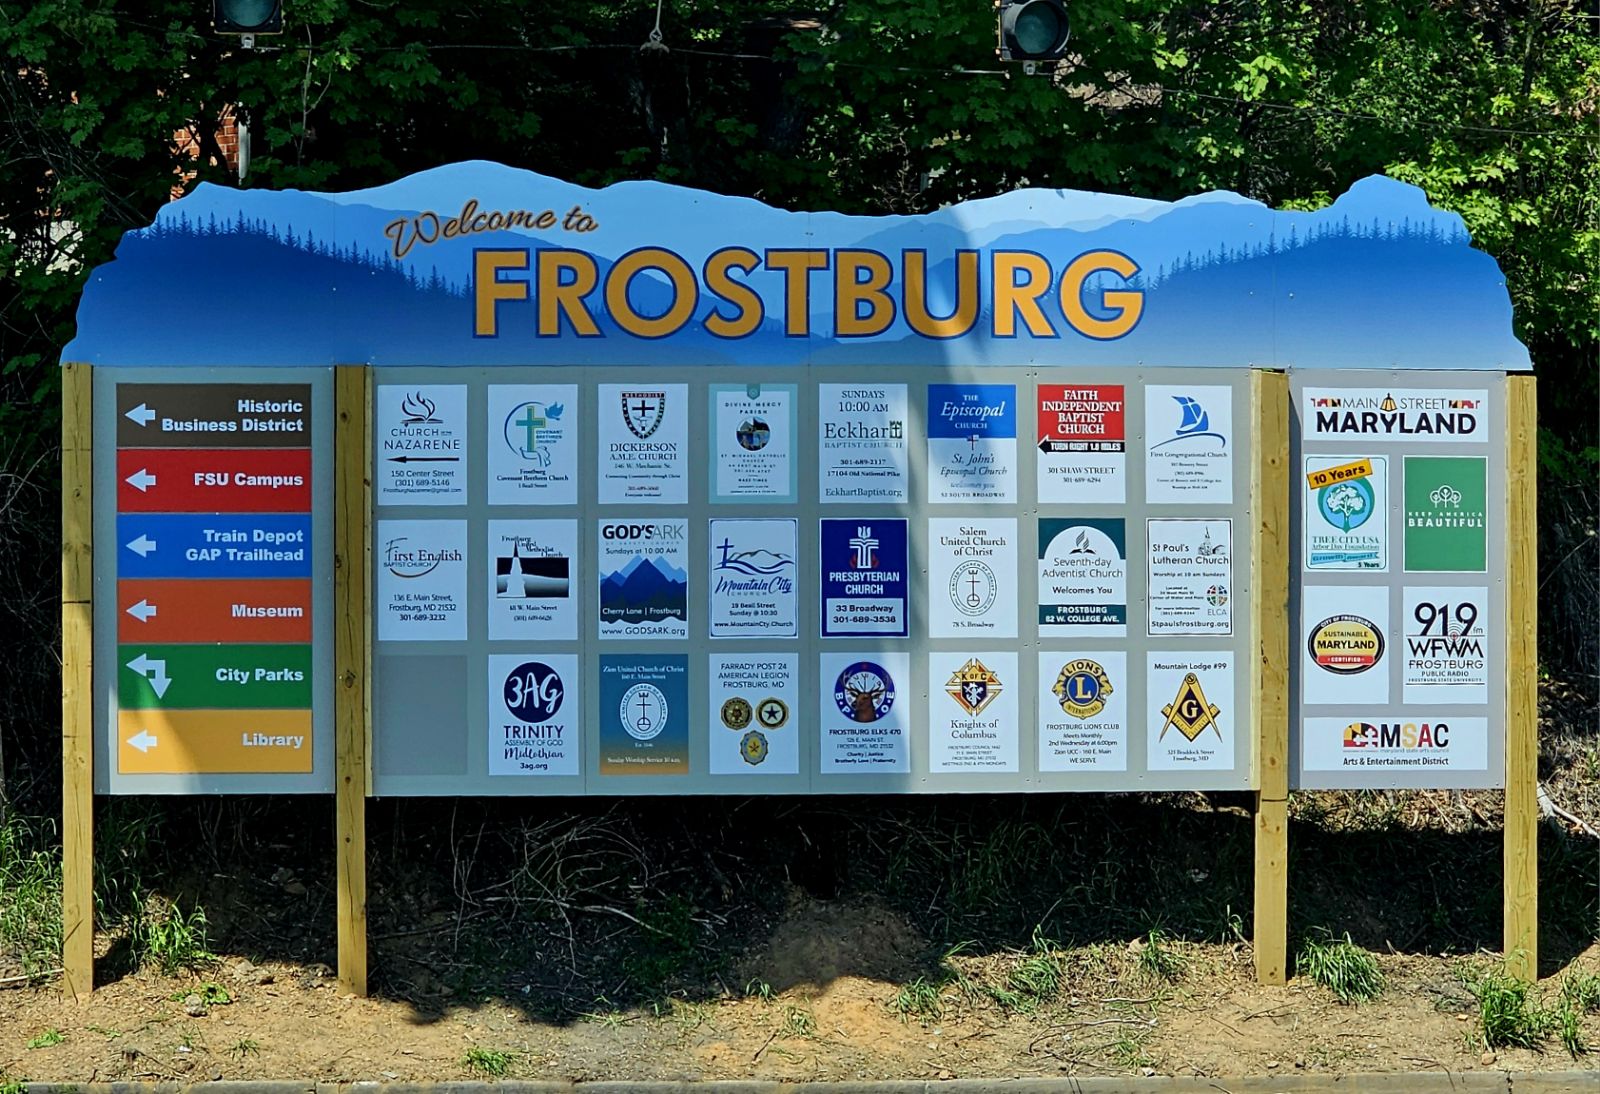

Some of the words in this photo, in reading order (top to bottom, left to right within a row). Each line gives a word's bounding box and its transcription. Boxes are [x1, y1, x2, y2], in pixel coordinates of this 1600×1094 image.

[384, 199, 556, 258] Welcome
[562, 205, 598, 232] to
[472, 246, 1145, 341] FROSTBURG
[1064, 390, 1098, 400] FAITH
[238, 400, 303, 412] Historic
[839, 402, 870, 412] 10:00
[873, 404, 888, 412] AM
[1042, 401, 1122, 411] INDEPENDENT
[1343, 397, 1379, 408] MAIN
[1400, 398, 1446, 410] STREET
[941, 401, 1005, 421] Episcopal
[1058, 413, 1104, 423] BAPTIST
[1317, 411, 1477, 434] MARYLAND
[162, 419, 237, 431] Business
[242, 419, 303, 431] District
[1058, 424, 1104, 434] CHURCH
[384, 440, 460, 450] NAZARENE
[610, 443, 677, 451] DICKERSON
[940, 466, 976, 477] Episcopal
[978, 466, 1007, 475] Church
[1314, 474, 1327, 485] 10
[1329, 465, 1365, 481] Years
[194, 473, 228, 485] FSU
[234, 473, 303, 488] Campus
[826, 488, 902, 497] EckhartBaptist.org
[1408, 518, 1483, 527] BEAUTIFUL
[960, 527, 987, 536] Salem
[204, 530, 247, 542] Train
[253, 530, 303, 545] Depot
[940, 537, 970, 546] United
[972, 537, 1006, 546] Church
[1312, 536, 1338, 544] TREE
[385, 537, 414, 562] First
[418, 549, 462, 564] English
[954, 547, 964, 556] of
[965, 547, 993, 556] Christ
[1163, 544, 1189, 552] Paul's
[186, 549, 220, 561] GAP
[226, 549, 303, 561] Trailhead
[1153, 556, 1192, 564] Lutheran
[1195, 556, 1229, 564] Church
[1054, 557, 1111, 568] Seventh-day
[829, 572, 900, 582] PRESBYTERIAN
[1042, 569, 1086, 577] Adventist
[1090, 569, 1123, 577] Church
[715, 576, 768, 596] Mountain
[768, 576, 792, 594] City
[845, 584, 884, 594] CHURCH
[1052, 586, 1094, 594] Welcomes
[1097, 586, 1112, 594] You
[232, 605, 303, 617] Museum
[389, 604, 422, 613] Frostburg,
[602, 608, 624, 616] Cherry
[849, 605, 893, 613] Broadway
[1057, 606, 1107, 614] FROSTBURG
[602, 627, 685, 636] www.GODSARK.org
[1317, 640, 1375, 649] MARYLAND
[1407, 638, 1484, 658] WFWM
[1066, 661, 1100, 674] LIONS
[1190, 663, 1212, 671] Lodge
[1409, 660, 1483, 669] FROSTBURG
[216, 668, 249, 684] City
[255, 669, 303, 681] Parks
[507, 672, 562, 713] 3AG
[1074, 677, 1091, 699] L
[1181, 700, 1198, 718] G
[951, 720, 986, 730] Knights
[989, 719, 999, 728] of
[504, 726, 564, 738] TRINITY
[951, 730, 997, 739] Columbus
[1380, 723, 1449, 748] MSAC
[242, 733, 303, 748] Library
[505, 747, 564, 760] Midlothian
[1343, 757, 1357, 766] Arts
[1359, 757, 1365, 765] &
[1367, 757, 1421, 766] Entertainment
[1422, 757, 1449, 765] District
